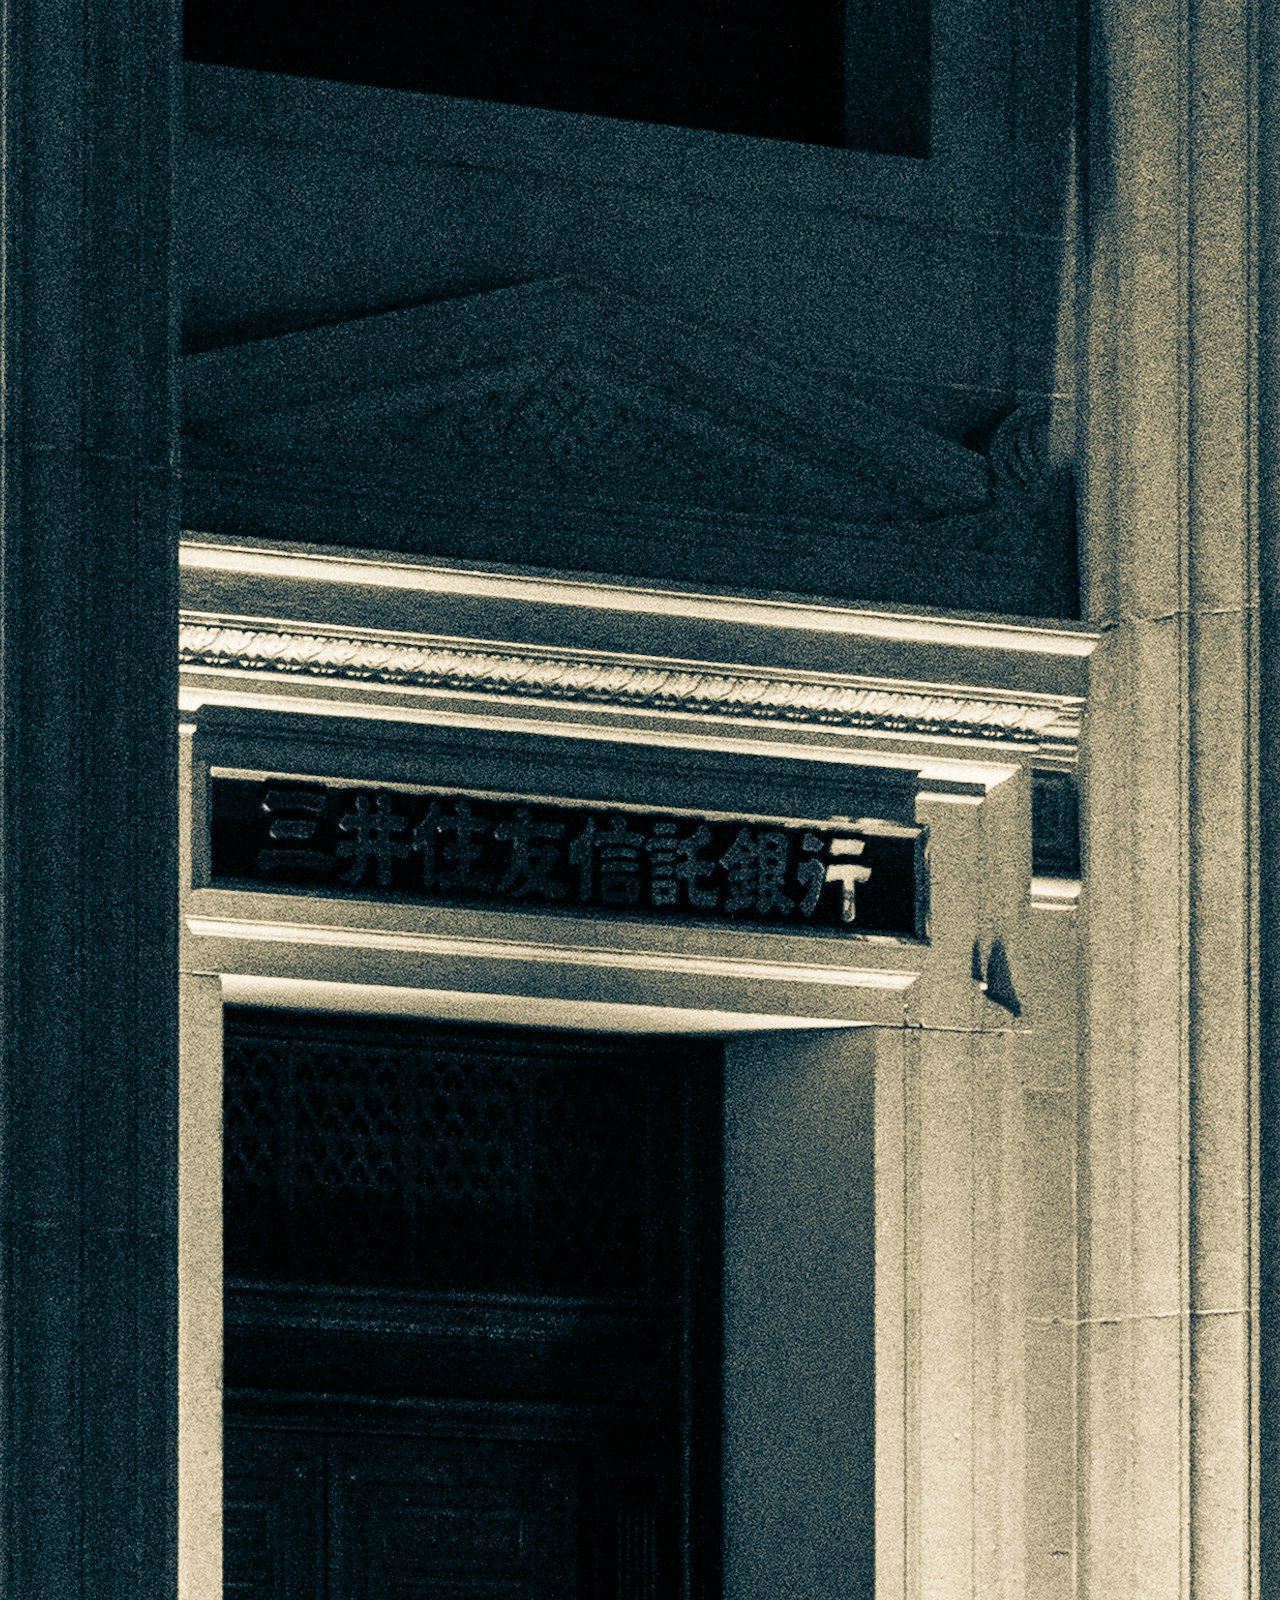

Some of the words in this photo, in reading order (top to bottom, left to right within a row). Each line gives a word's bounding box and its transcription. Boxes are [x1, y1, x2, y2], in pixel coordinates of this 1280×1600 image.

[255, 785, 873, 924] 三井住友信託銀行
